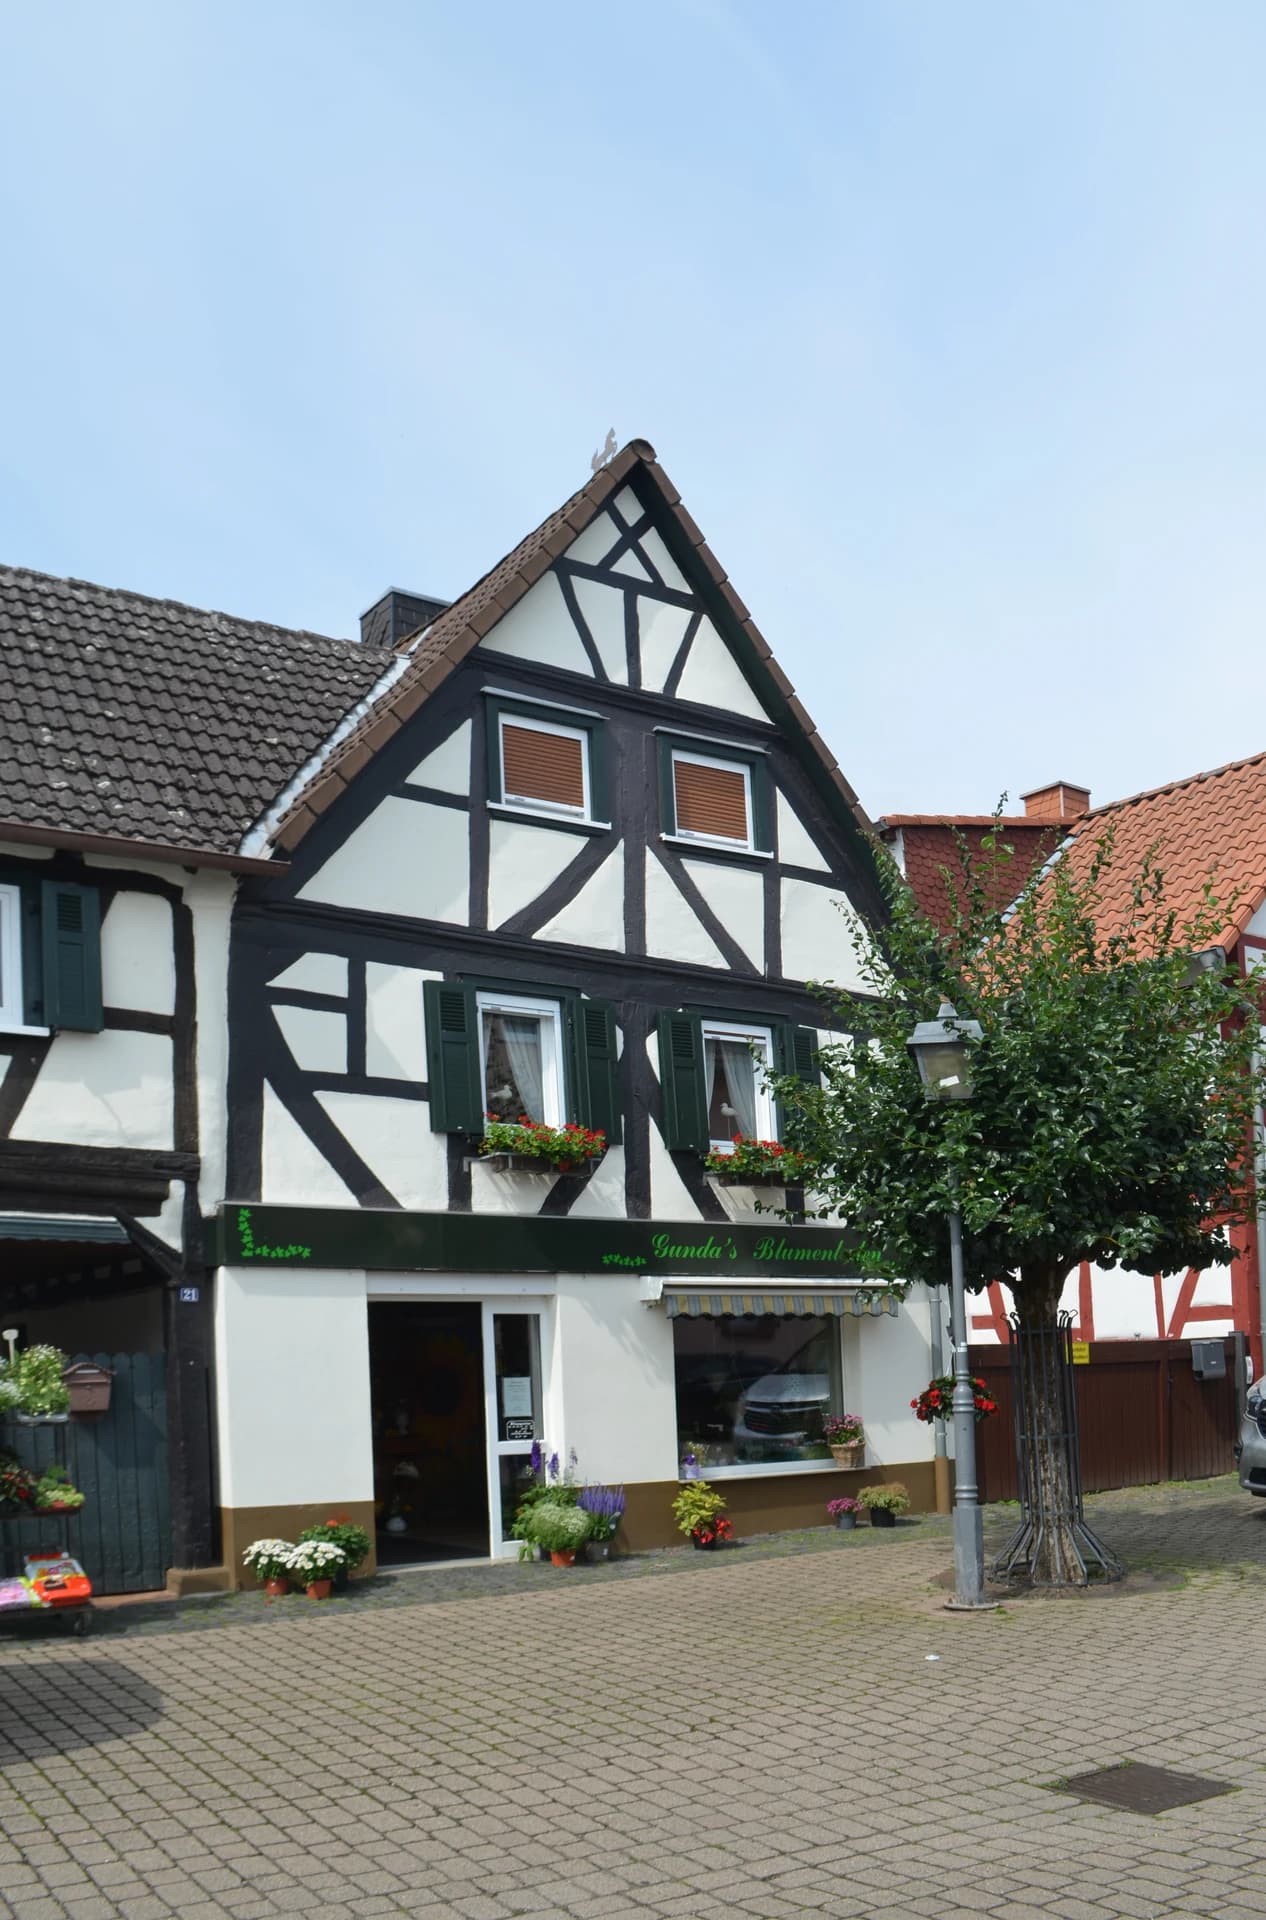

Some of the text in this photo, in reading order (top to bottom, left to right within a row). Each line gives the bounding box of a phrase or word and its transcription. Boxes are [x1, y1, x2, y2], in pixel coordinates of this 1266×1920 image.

[651, 1233, 882, 1262] Gunda's Blumenlden
[183, 1288, 196, 1301] 21
